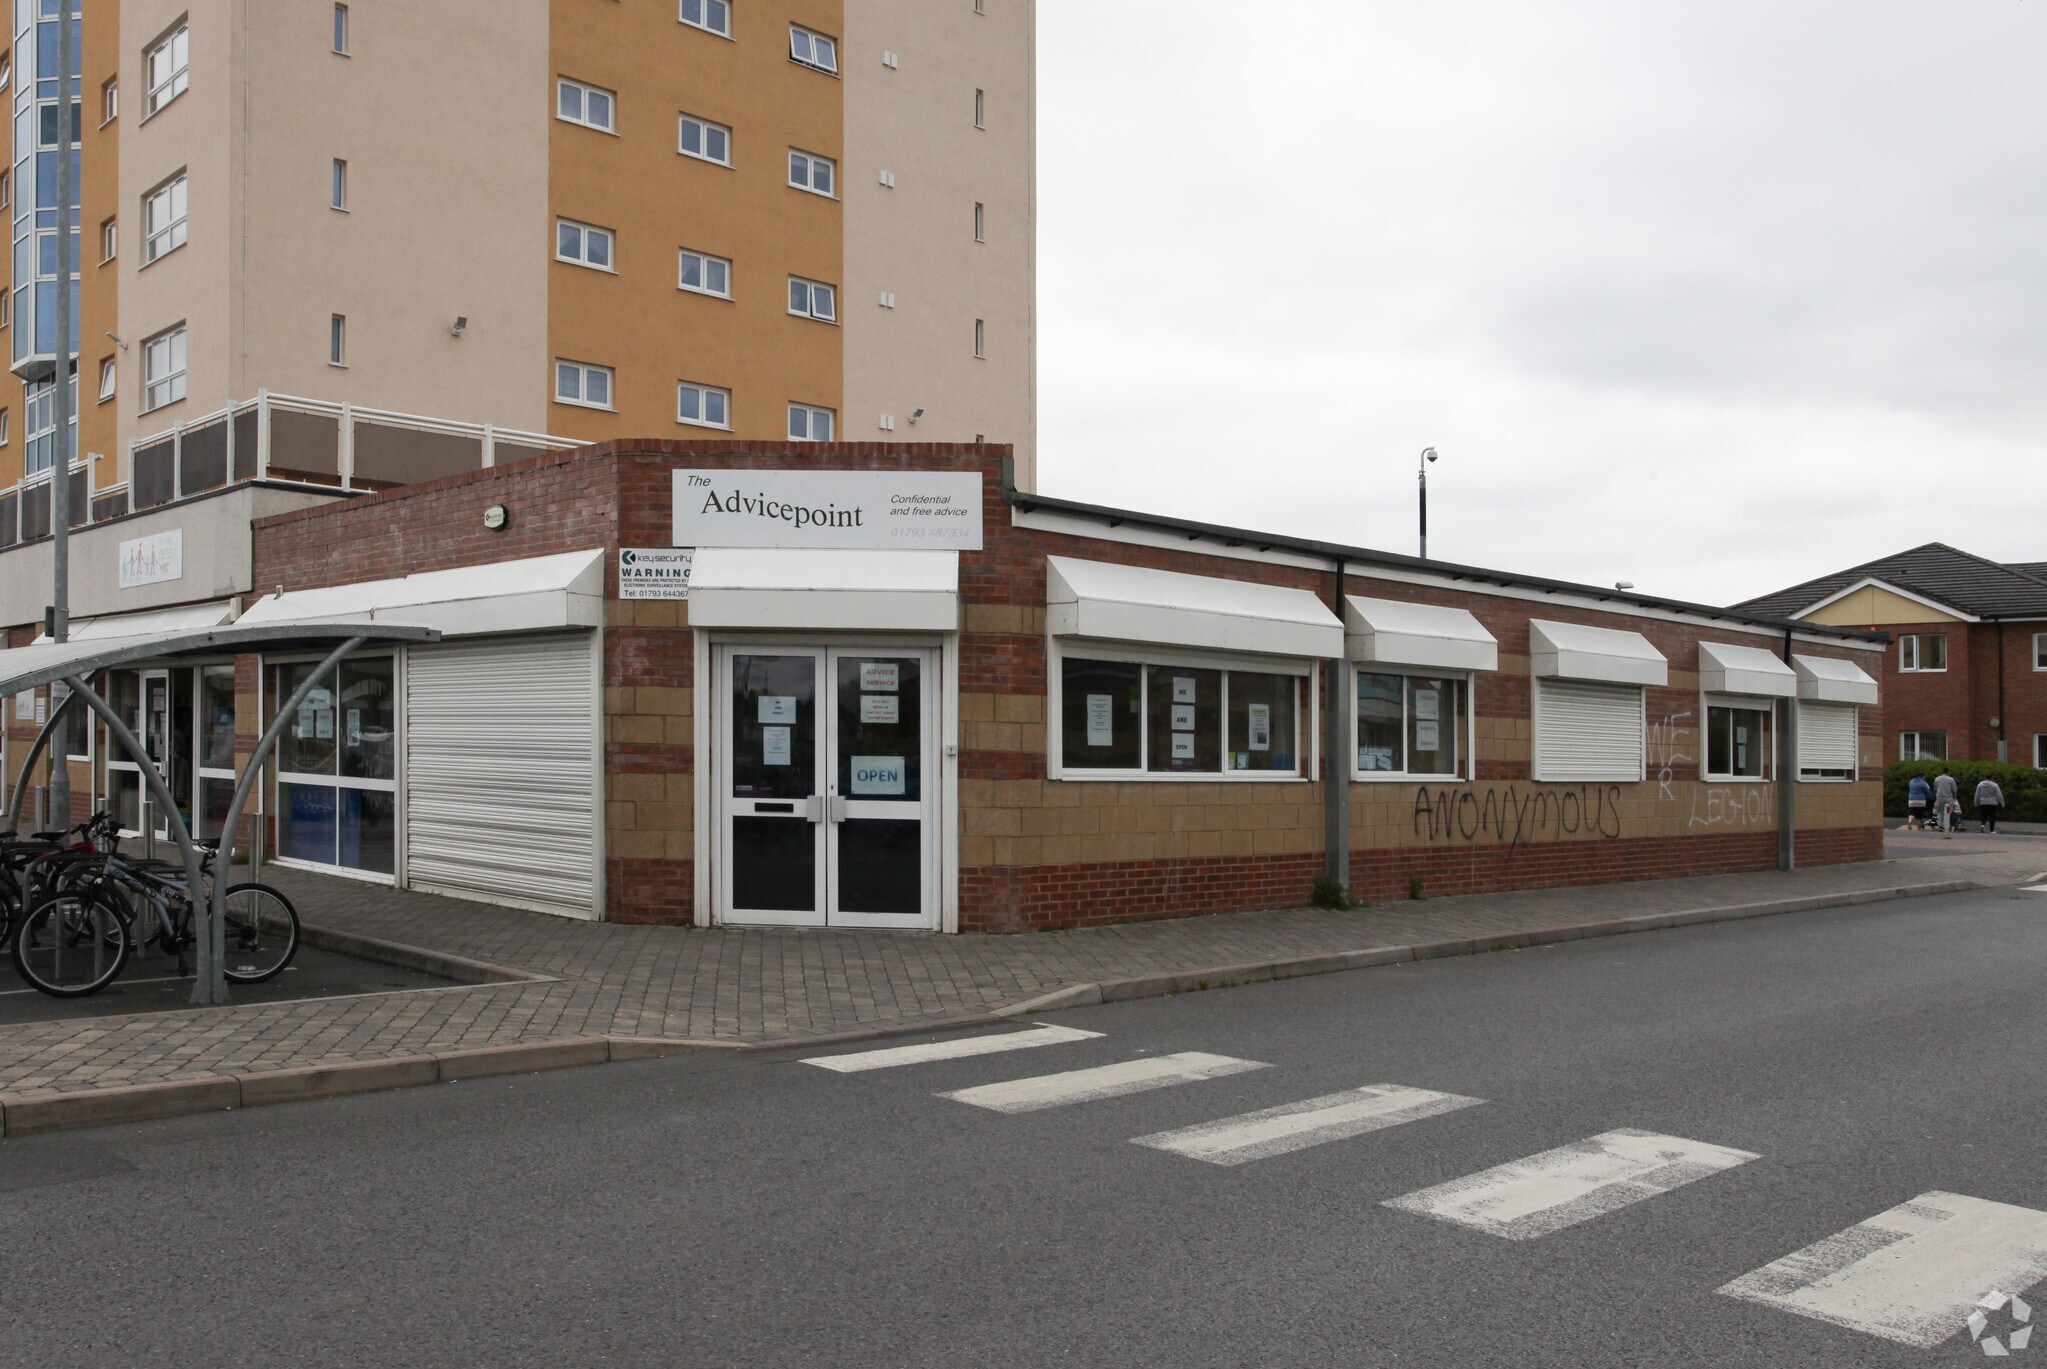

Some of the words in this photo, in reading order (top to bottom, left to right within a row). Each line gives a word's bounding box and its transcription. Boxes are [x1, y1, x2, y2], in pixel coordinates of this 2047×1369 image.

[687, 475, 711, 487] The
[890, 494, 951, 504] Confidential
[701, 490, 863, 528] Advicepoint
[890, 507, 910, 516] and
[912, 506, 932, 516] free
[934, 507, 968, 516] advice
[621, 568, 691, 577] WARNING
[1645, 711, 1691, 766] WE
[857, 769, 898, 782] OPEN
[1658, 767, 1674, 800] R
